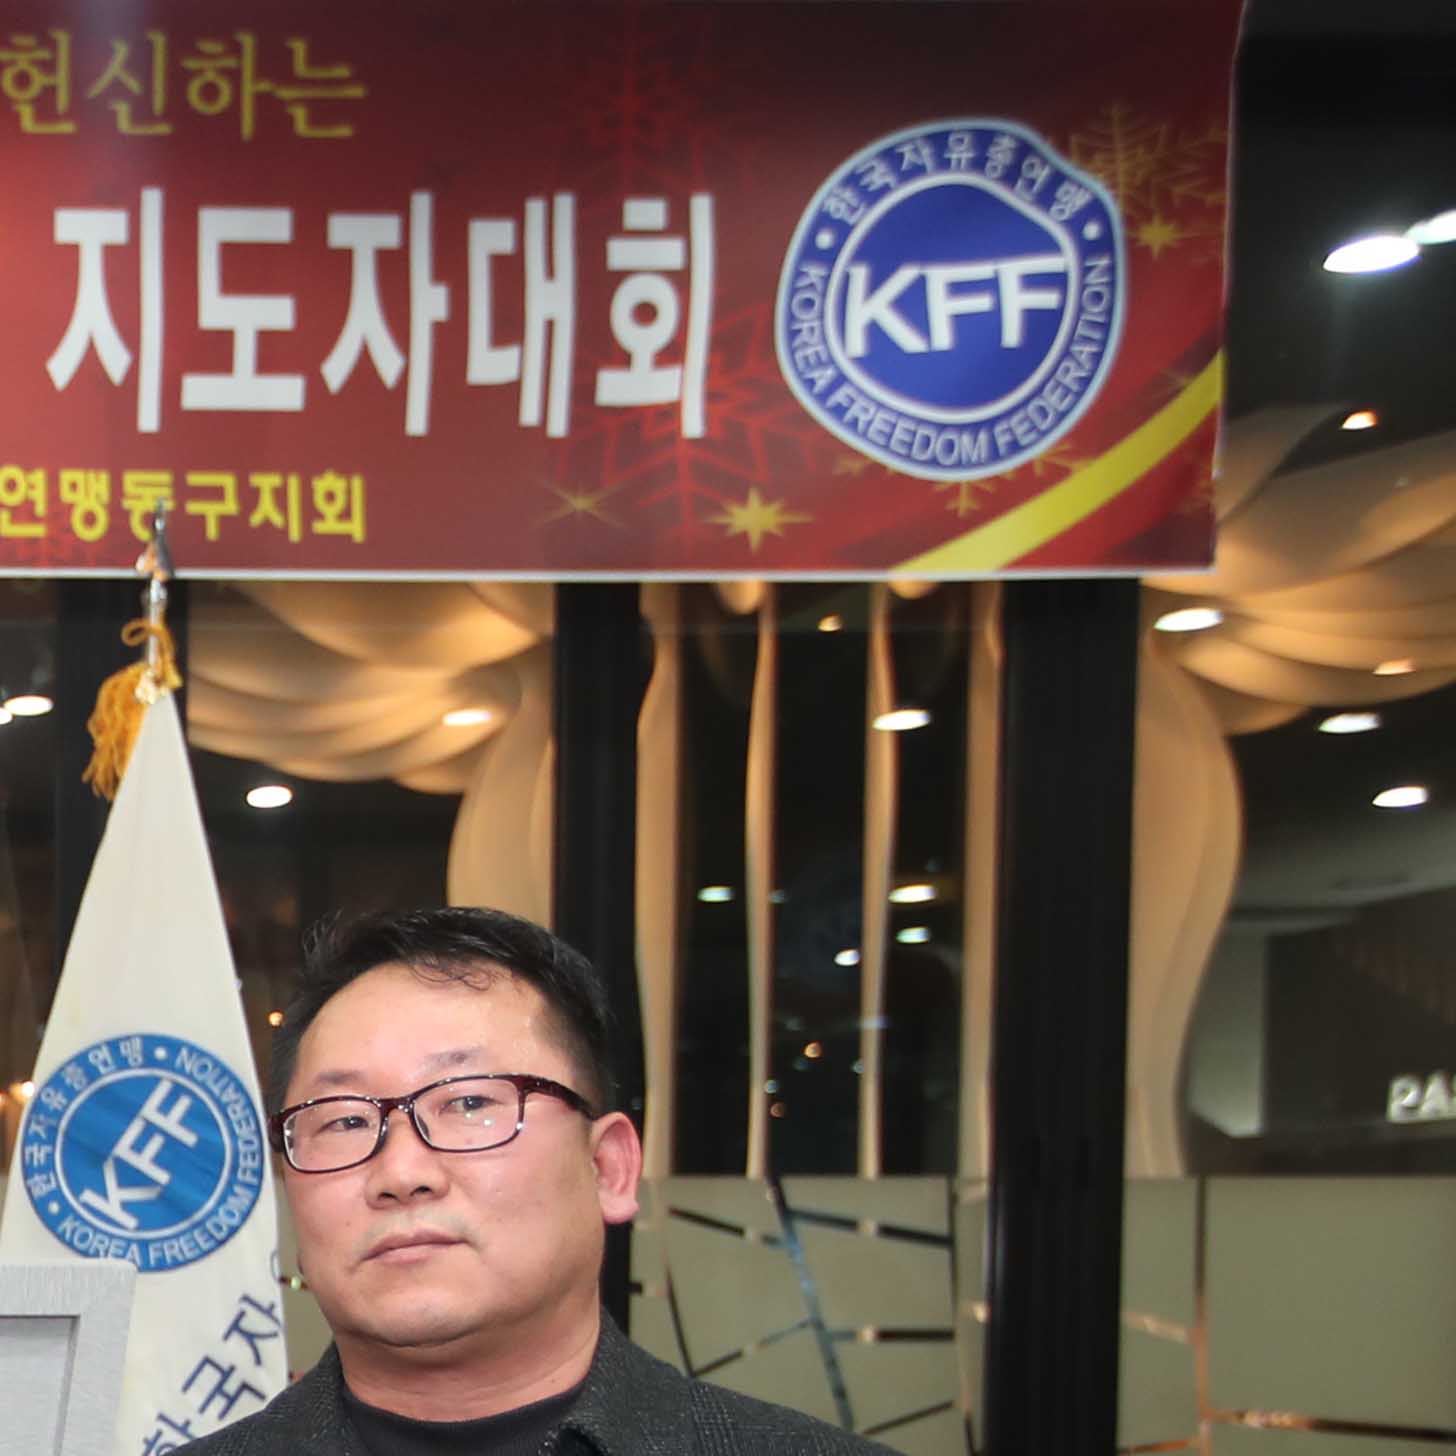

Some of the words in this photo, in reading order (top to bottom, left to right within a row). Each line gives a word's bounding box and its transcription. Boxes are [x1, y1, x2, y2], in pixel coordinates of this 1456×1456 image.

[45, 186, 717, 441] 지도자대회
[790, 264, 836, 395] KOREA
[825, 384, 988, 466] FREEDOM
[994, 255, 1112, 457] FEDERATION
[845, 254, 1065, 360] KFF
[78, 1077, 200, 1231] KFF
[174, 1045, 261, 1186] FEDERATION
[1386, 1068, 1456, 1124] PA
[150, 1186, 256, 1267] FREEDOM
